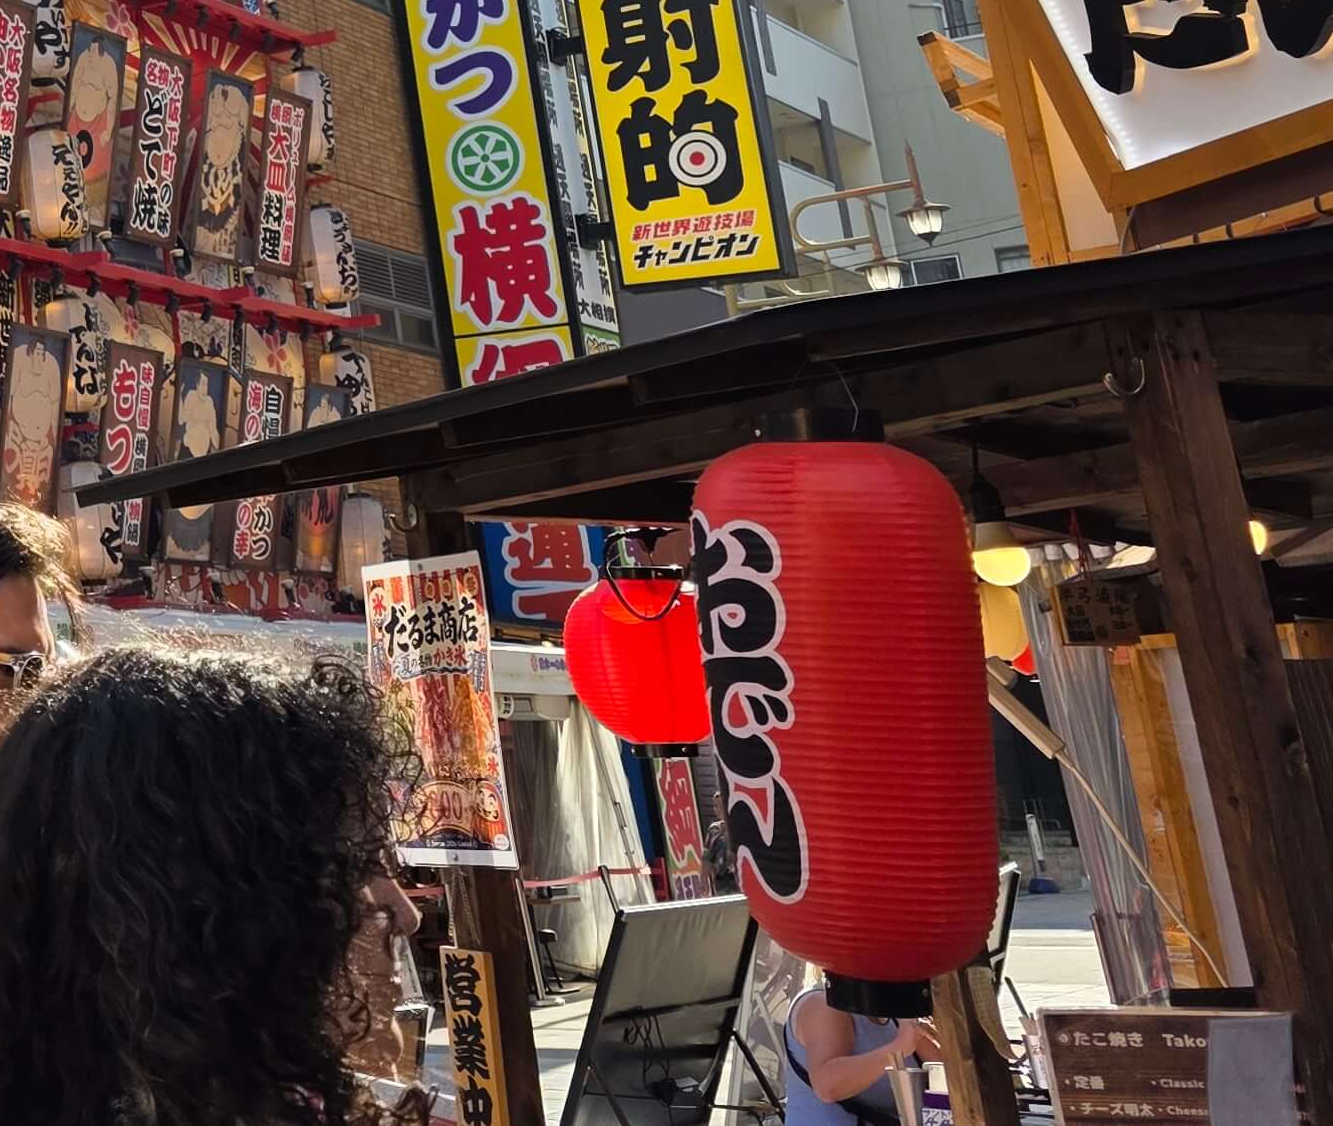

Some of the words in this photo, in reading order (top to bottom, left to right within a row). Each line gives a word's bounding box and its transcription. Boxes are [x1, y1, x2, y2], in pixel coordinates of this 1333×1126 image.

[133, 90, 170, 232] どて焼
[157, 67, 184, 237] 大阪下町の味
[632, 210, 756, 242] 新世界遊技場
[634, 233, 758, 270] チャンピオン
[384, 596, 479, 658] だるま商店
[433, 644, 468, 667] かき氷
[445, 952, 495, 1126] 営業中
[1073, 1031, 1144, 1049] たこ焼き
[1162, 1032, 1207, 1049] Tako
[1074, 1075, 1106, 1090] 定番
[1159, 1077, 1205, 1090] Classic
[1082, 1102, 1157, 1118] チーズ明太
